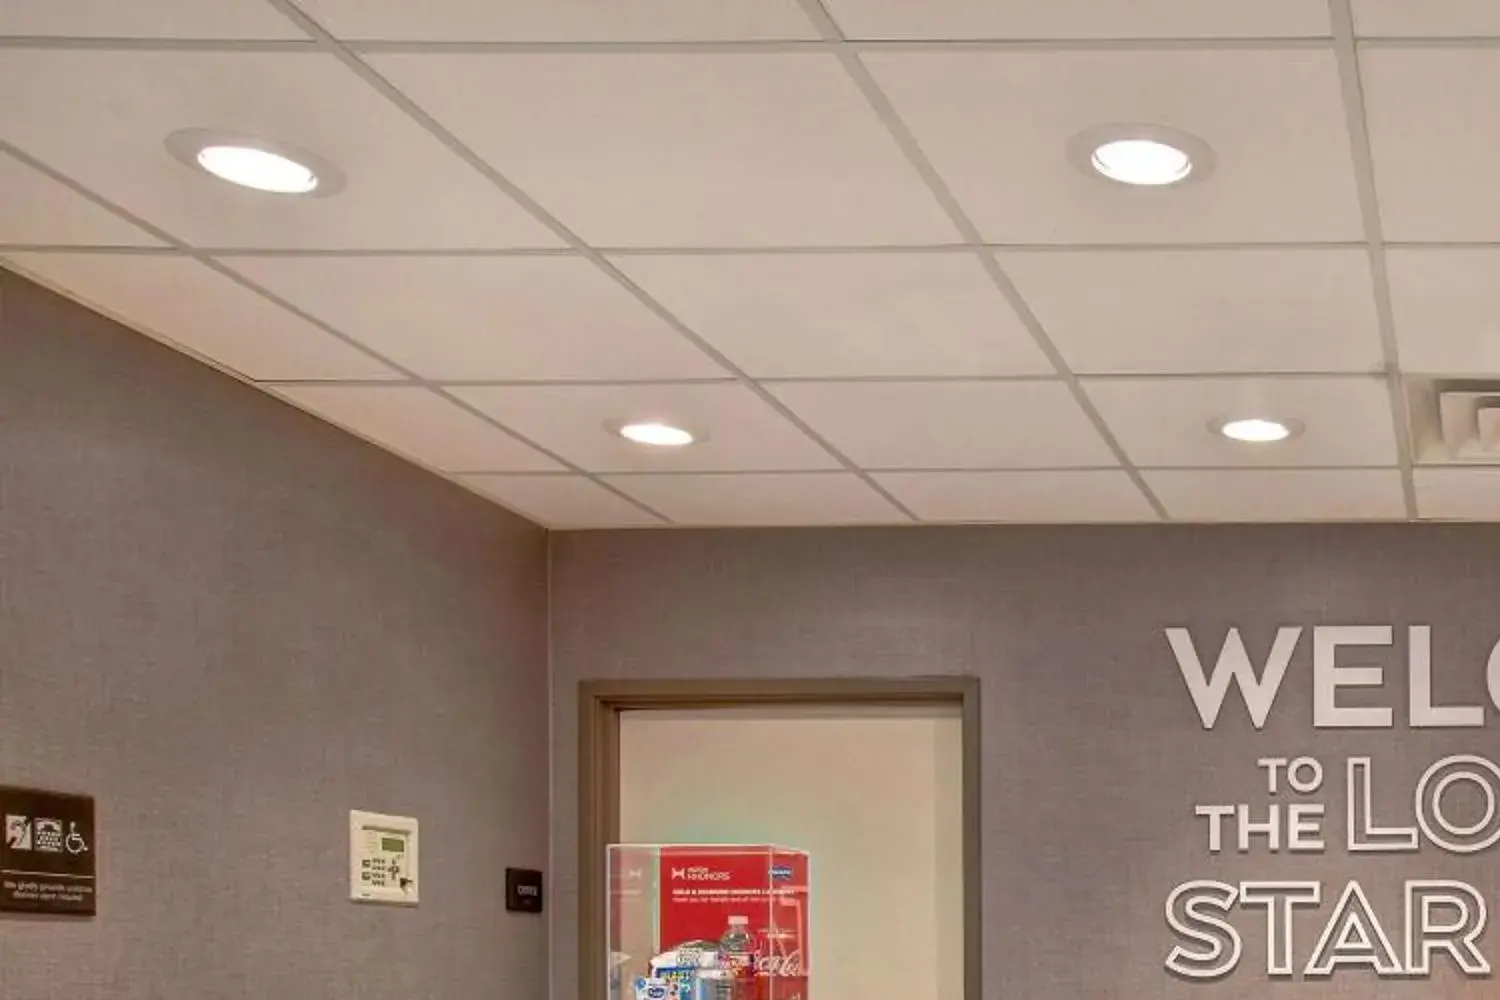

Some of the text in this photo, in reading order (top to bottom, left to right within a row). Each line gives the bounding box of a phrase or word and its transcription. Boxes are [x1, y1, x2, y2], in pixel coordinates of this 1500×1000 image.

[1257, 756, 1323, 794] TO
[1195, 804, 1325, 851] THE
[1164, 880, 1491, 977] STAR
